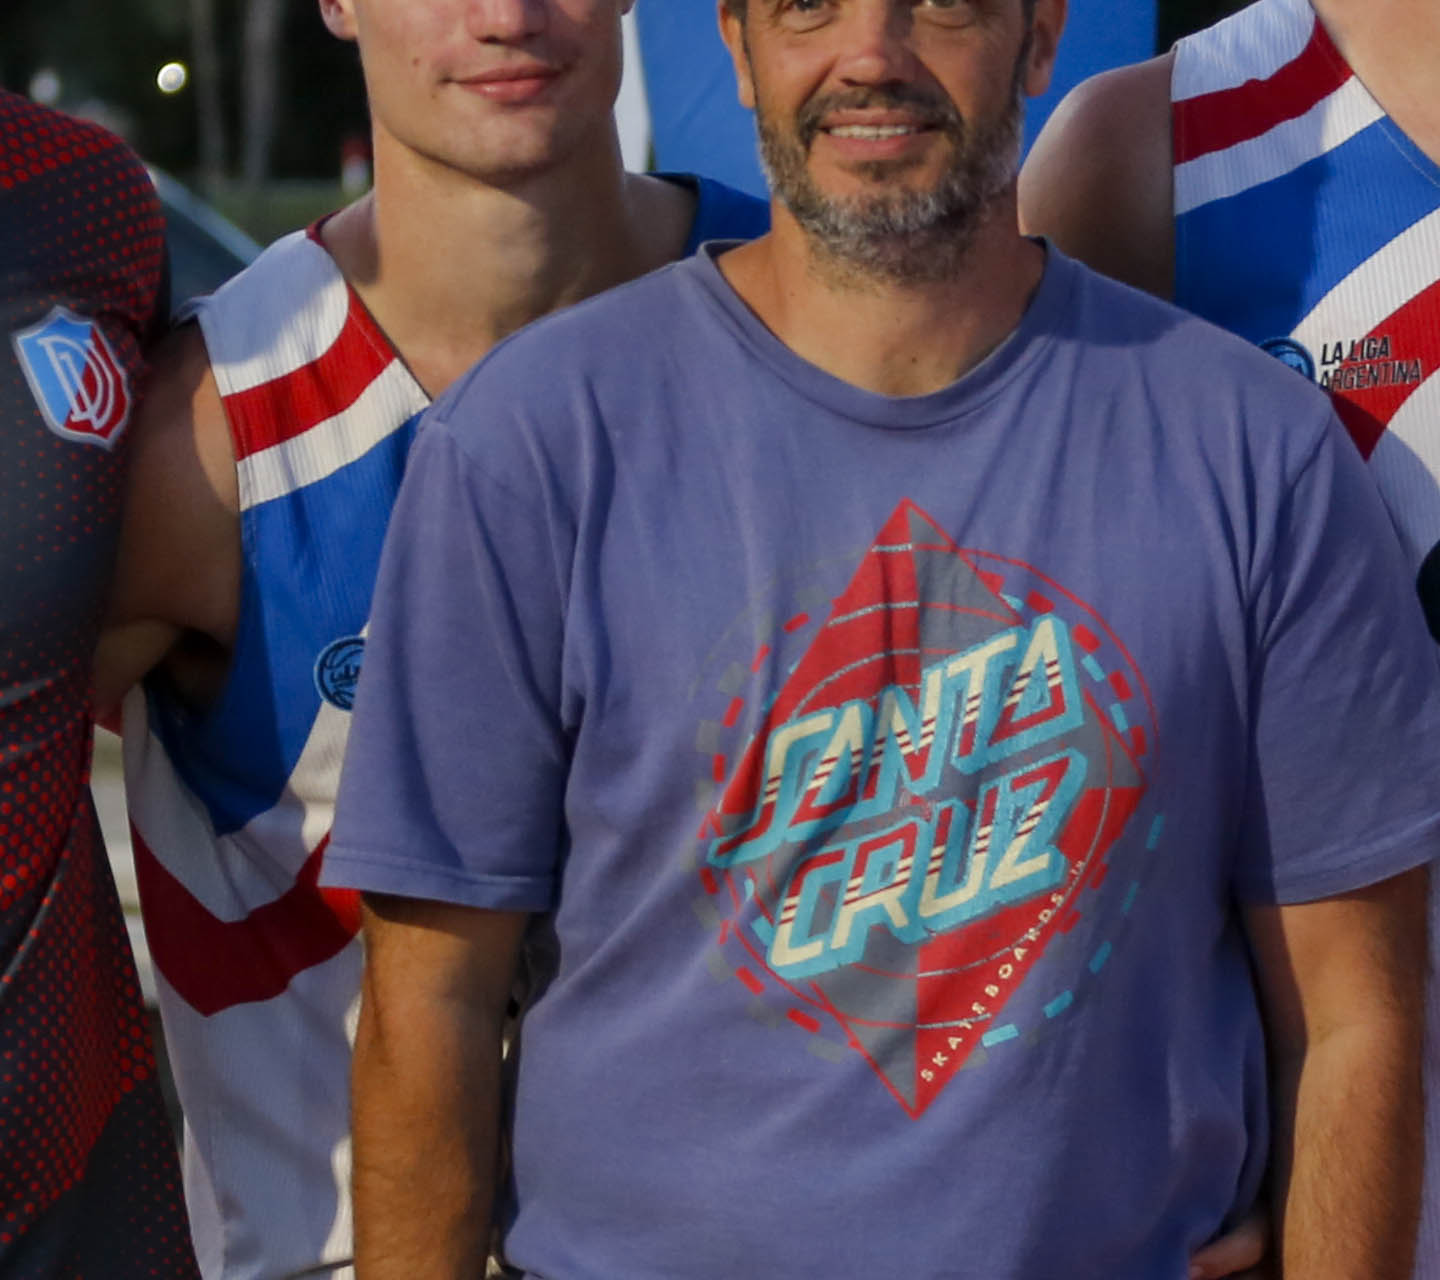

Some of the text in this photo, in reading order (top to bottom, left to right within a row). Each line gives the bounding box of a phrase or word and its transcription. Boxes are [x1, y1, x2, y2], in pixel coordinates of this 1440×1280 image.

[1320, 358, 1422, 392] ARGENTINA
[1321, 336, 1390, 365] LA LIGA
[712, 615, 1075, 862] SANTA
[767, 752, 1078, 970] CRUZ
